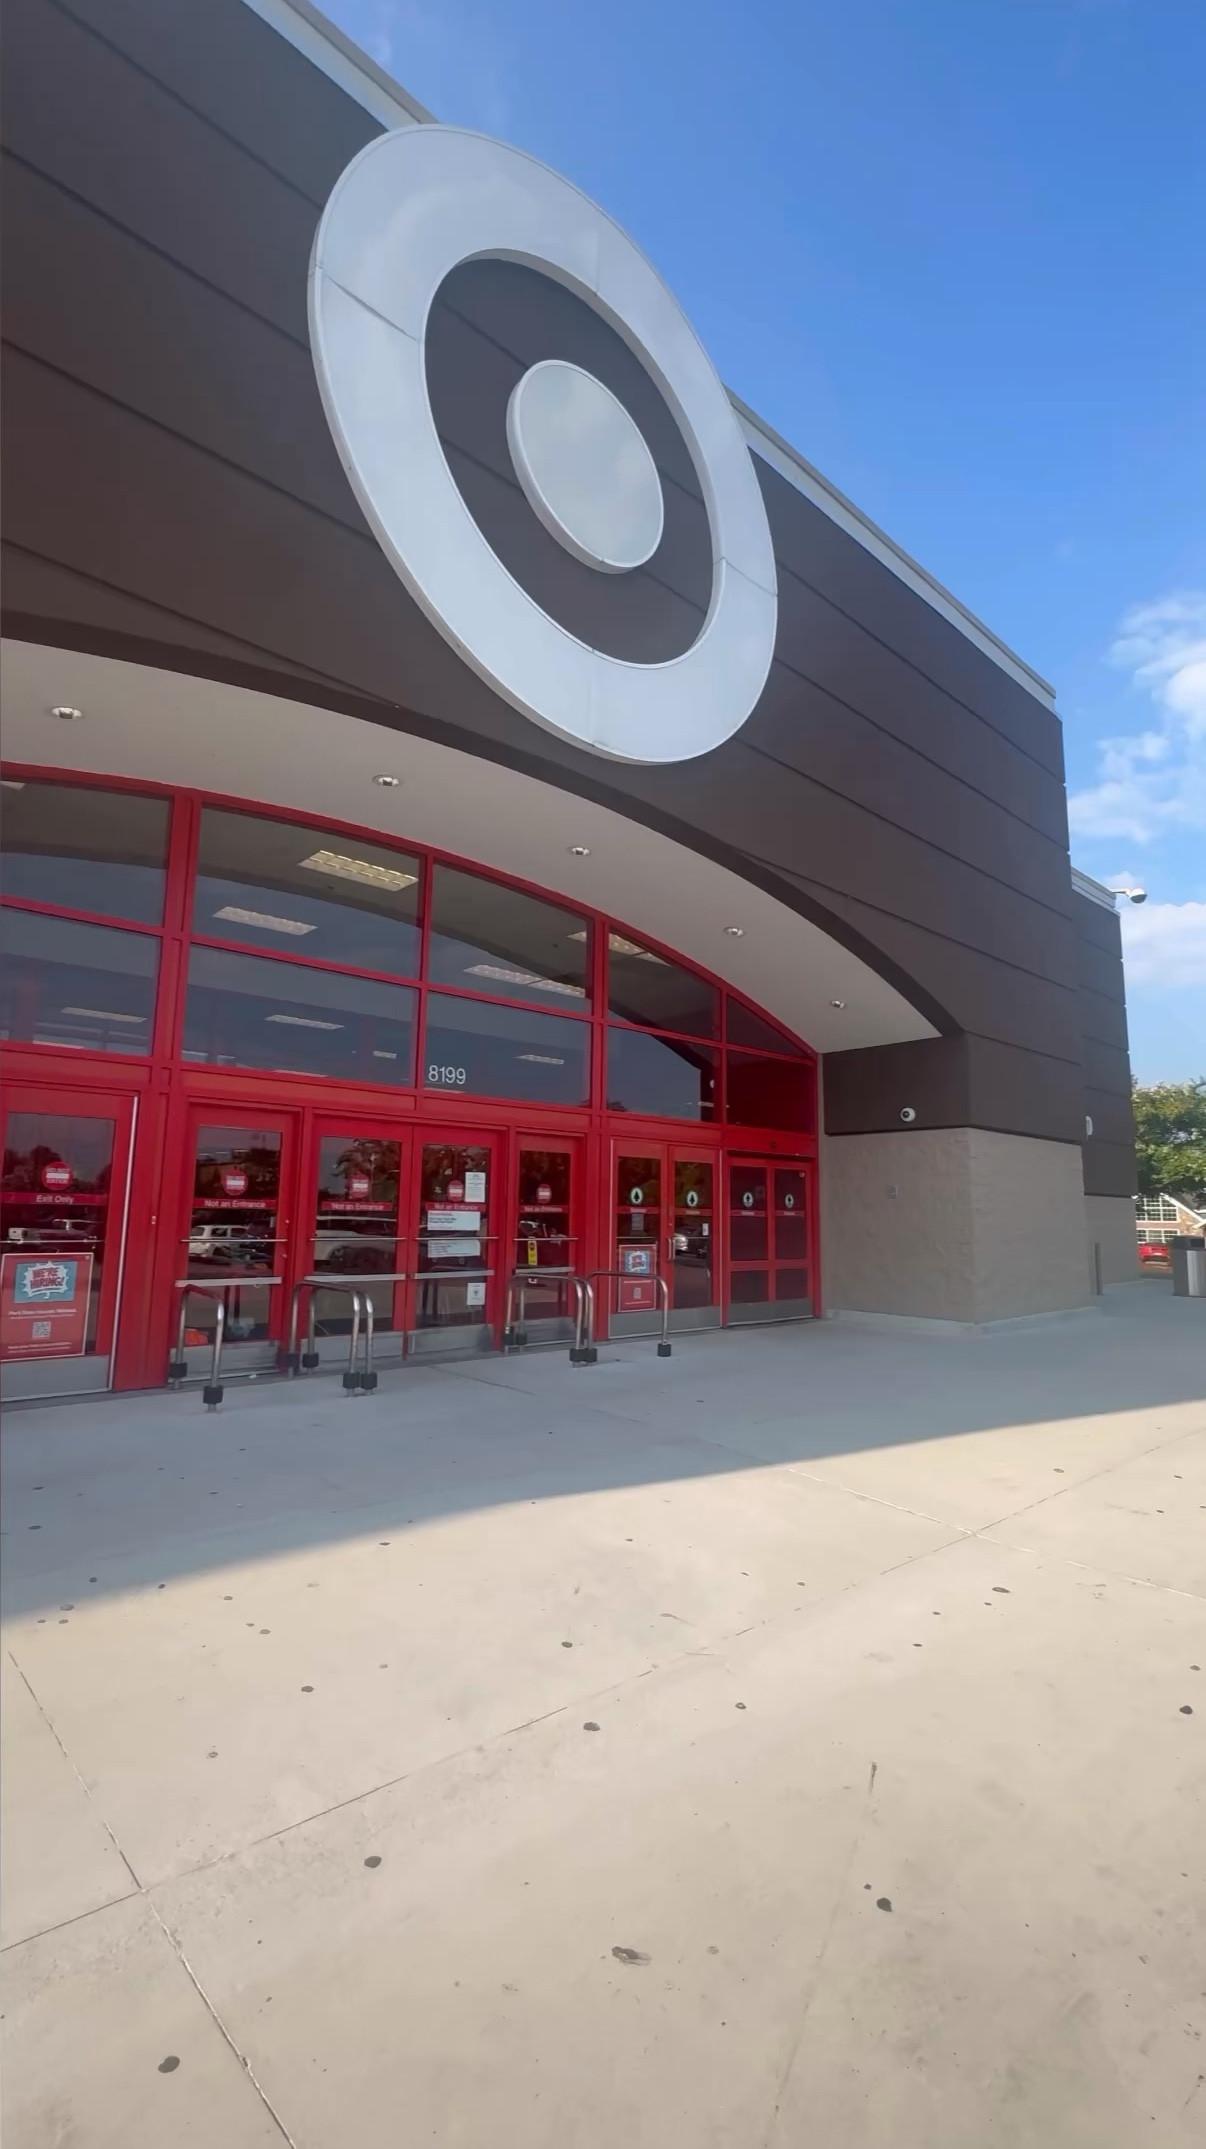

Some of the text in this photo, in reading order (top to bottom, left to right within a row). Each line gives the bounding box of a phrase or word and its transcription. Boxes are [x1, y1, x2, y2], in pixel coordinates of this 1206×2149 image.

[428, 1064, 466, 1085] 8199
[36, 1195, 74, 1204] Exit Only
[232, 1200, 266, 1208] Entrance
[32, 1268, 59, 1279] WE'RE
[30, 1276, 65, 1289] HIRING!
